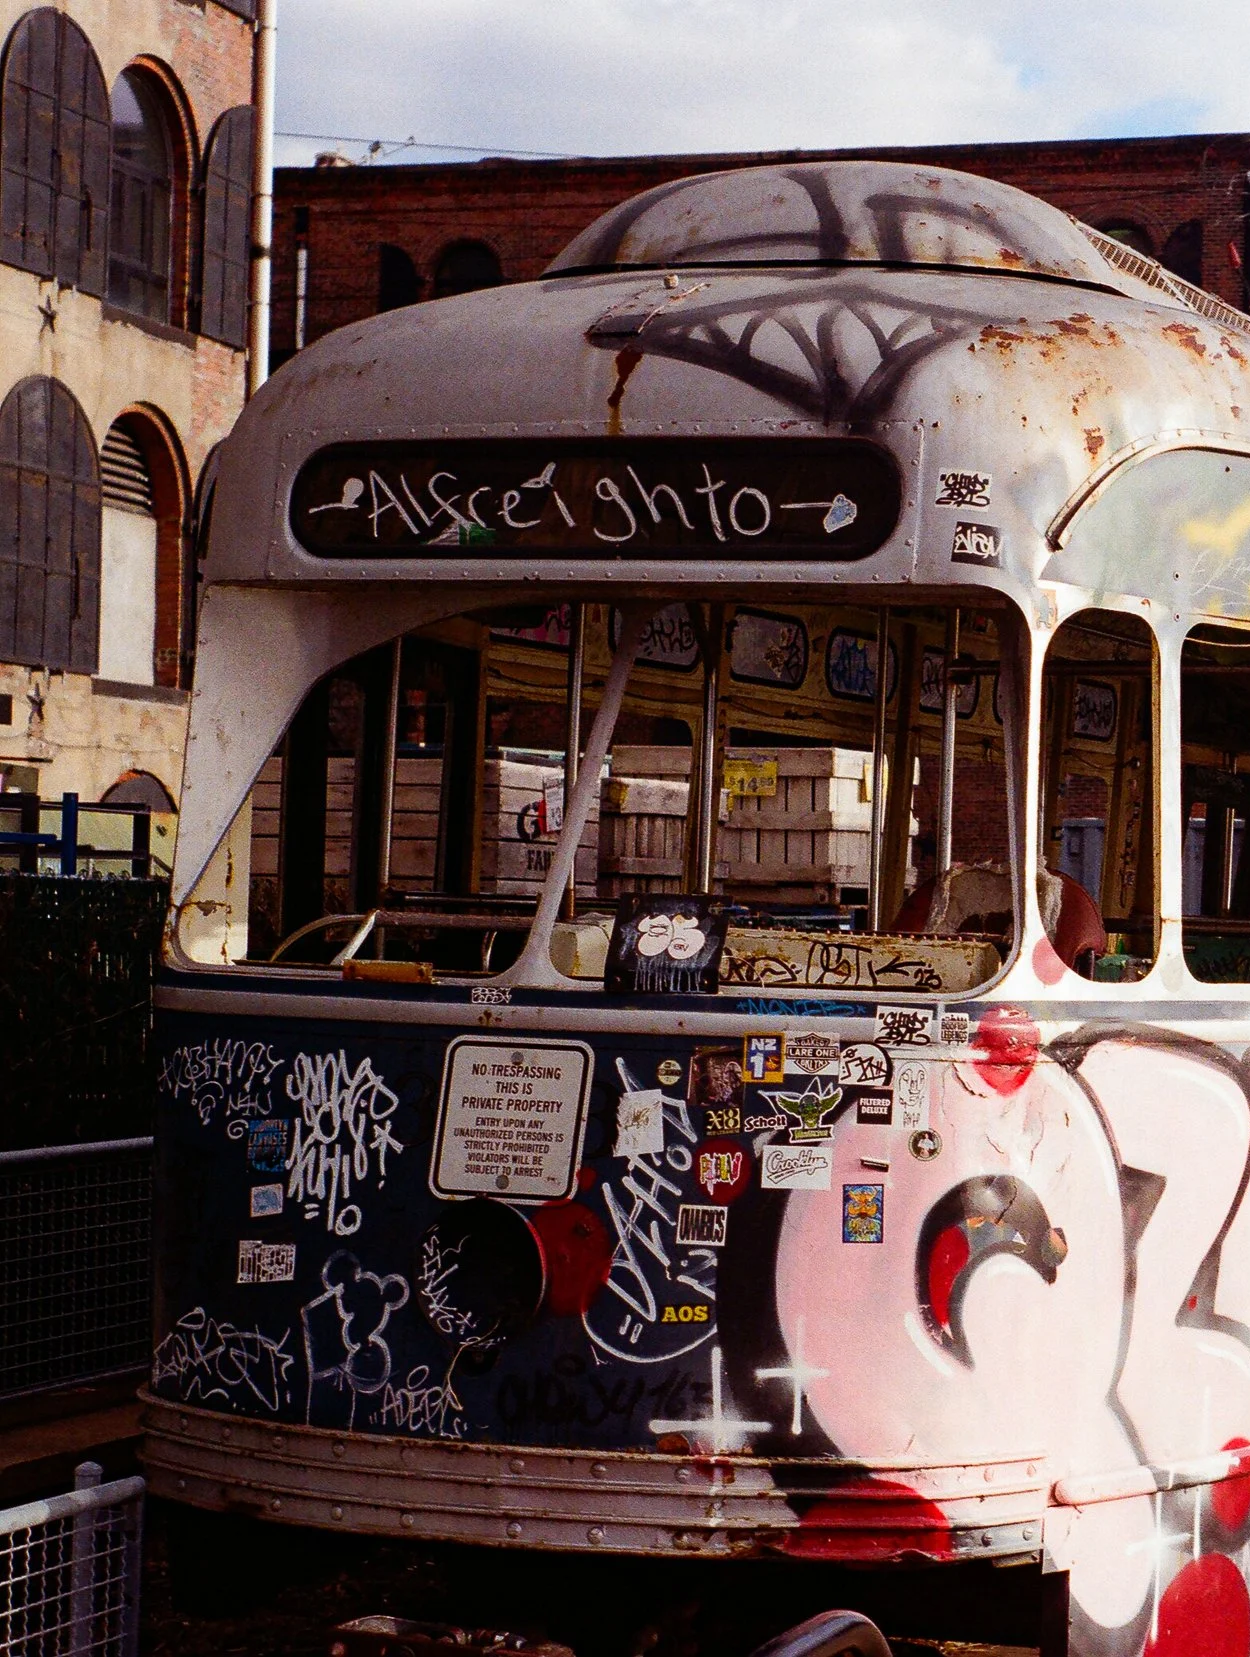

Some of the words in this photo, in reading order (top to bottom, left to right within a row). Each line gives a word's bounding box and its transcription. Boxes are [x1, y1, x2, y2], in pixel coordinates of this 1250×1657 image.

[751, 1038, 777, 1051] NZ
[789, 1048, 813, 1056] LARE
[815, 1049, 836, 1057] ONE
[472, 1063, 487, 1076] NO
[491, 1064, 562, 1080] TRESPASSING
[495, 1081, 519, 1094] THIS
[522, 1082, 533, 1095] IS
[461, 1096, 502, 1111] PRIVATE
[506, 1098, 563, 1113] PROPERTY
[859, 1097, 891, 1107] FILTERED
[861, 1106, 888, 1115] DELUXE
[475, 1116, 501, 1127] ENTRY
[503, 1118, 526, 1129] UPON
[527, 1120, 545, 1130] ANY
[744, 1115, 787, 1132] Schott
[453, 1127, 514, 1140] UNAUTHORIZED
[515, 1131, 553, 1142] PERSONS
[555, 1133, 564, 1143] IS
[464, 1141, 500, 1152] STRICTLY
[502, 1142, 550, 1154] PROHIBITED
[467, 1152, 510, 1164] VIOLATORS
[512, 1154, 530, 1165] WILL
[532, 1155, 543, 1166] BE
[464, 1163, 500, 1175] SUBJECT
[502, 1166, 511, 1176] TO
[513, 1166, 544, 1178] ARREST
[661, 1305, 709, 1322] AOS
